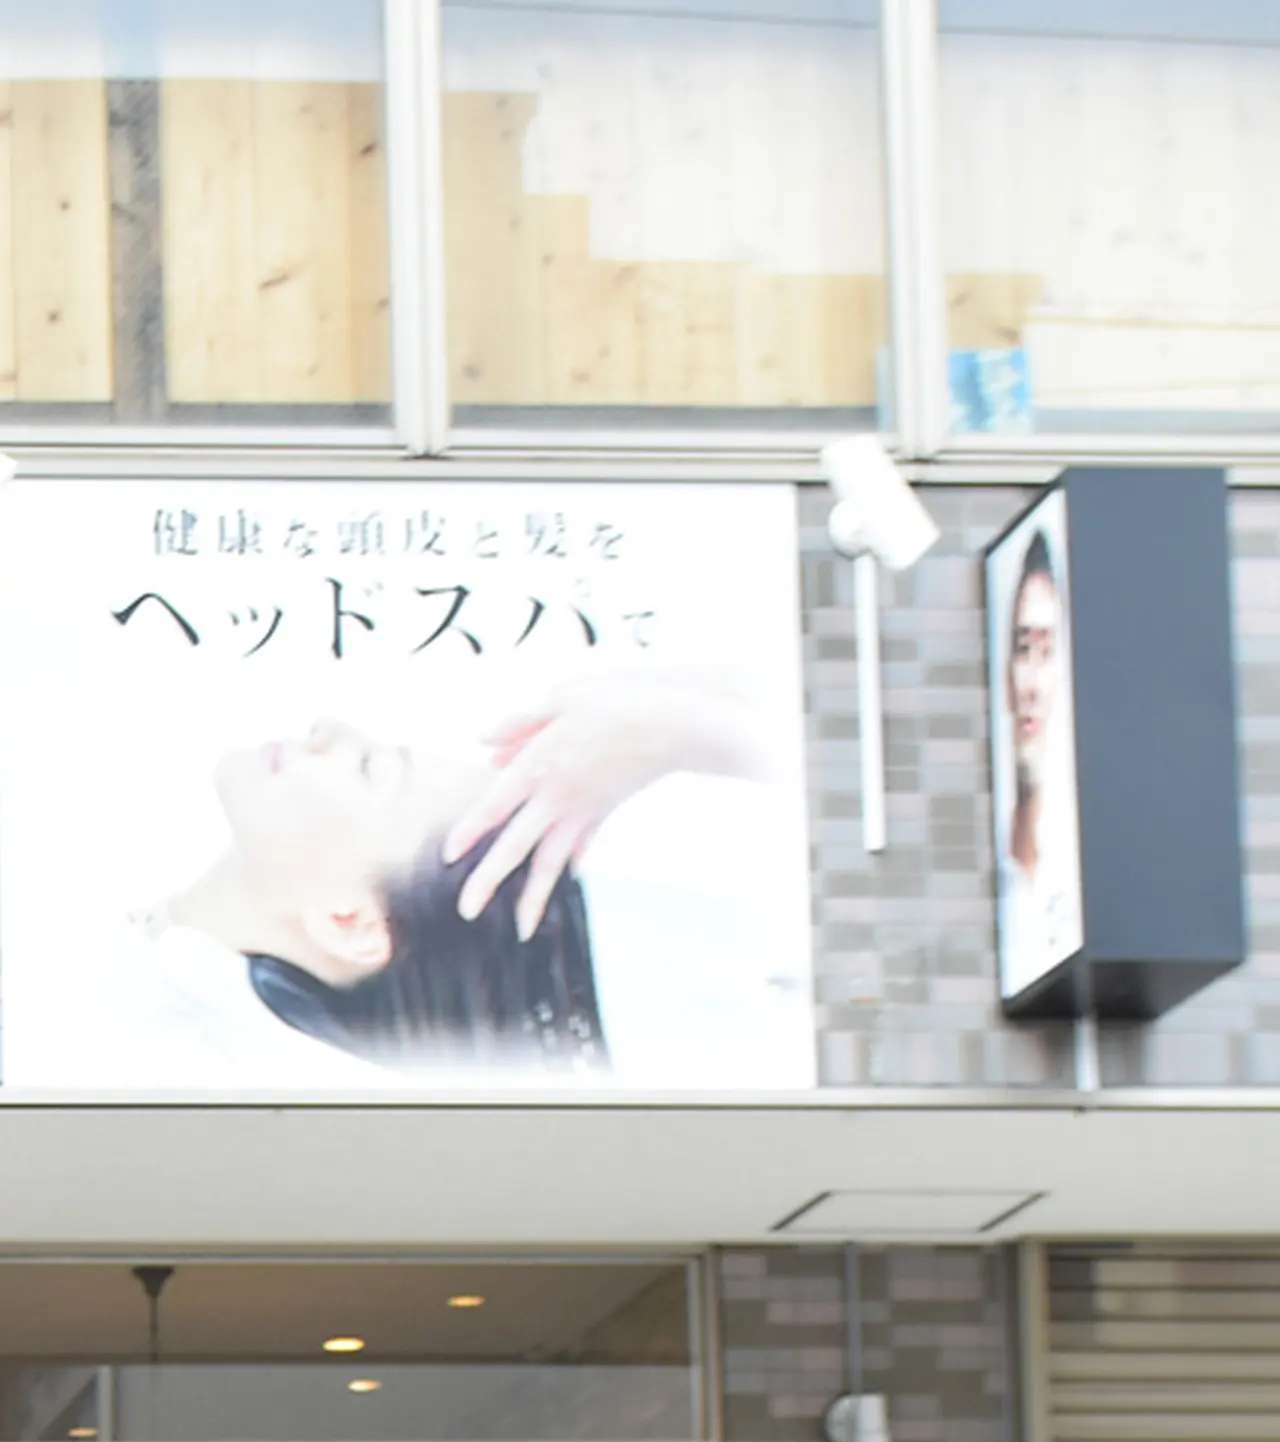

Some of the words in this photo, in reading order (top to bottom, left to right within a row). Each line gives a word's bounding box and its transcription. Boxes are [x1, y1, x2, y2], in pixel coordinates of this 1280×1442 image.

[151, 507, 627, 561] 健康な頭皮と髪を
